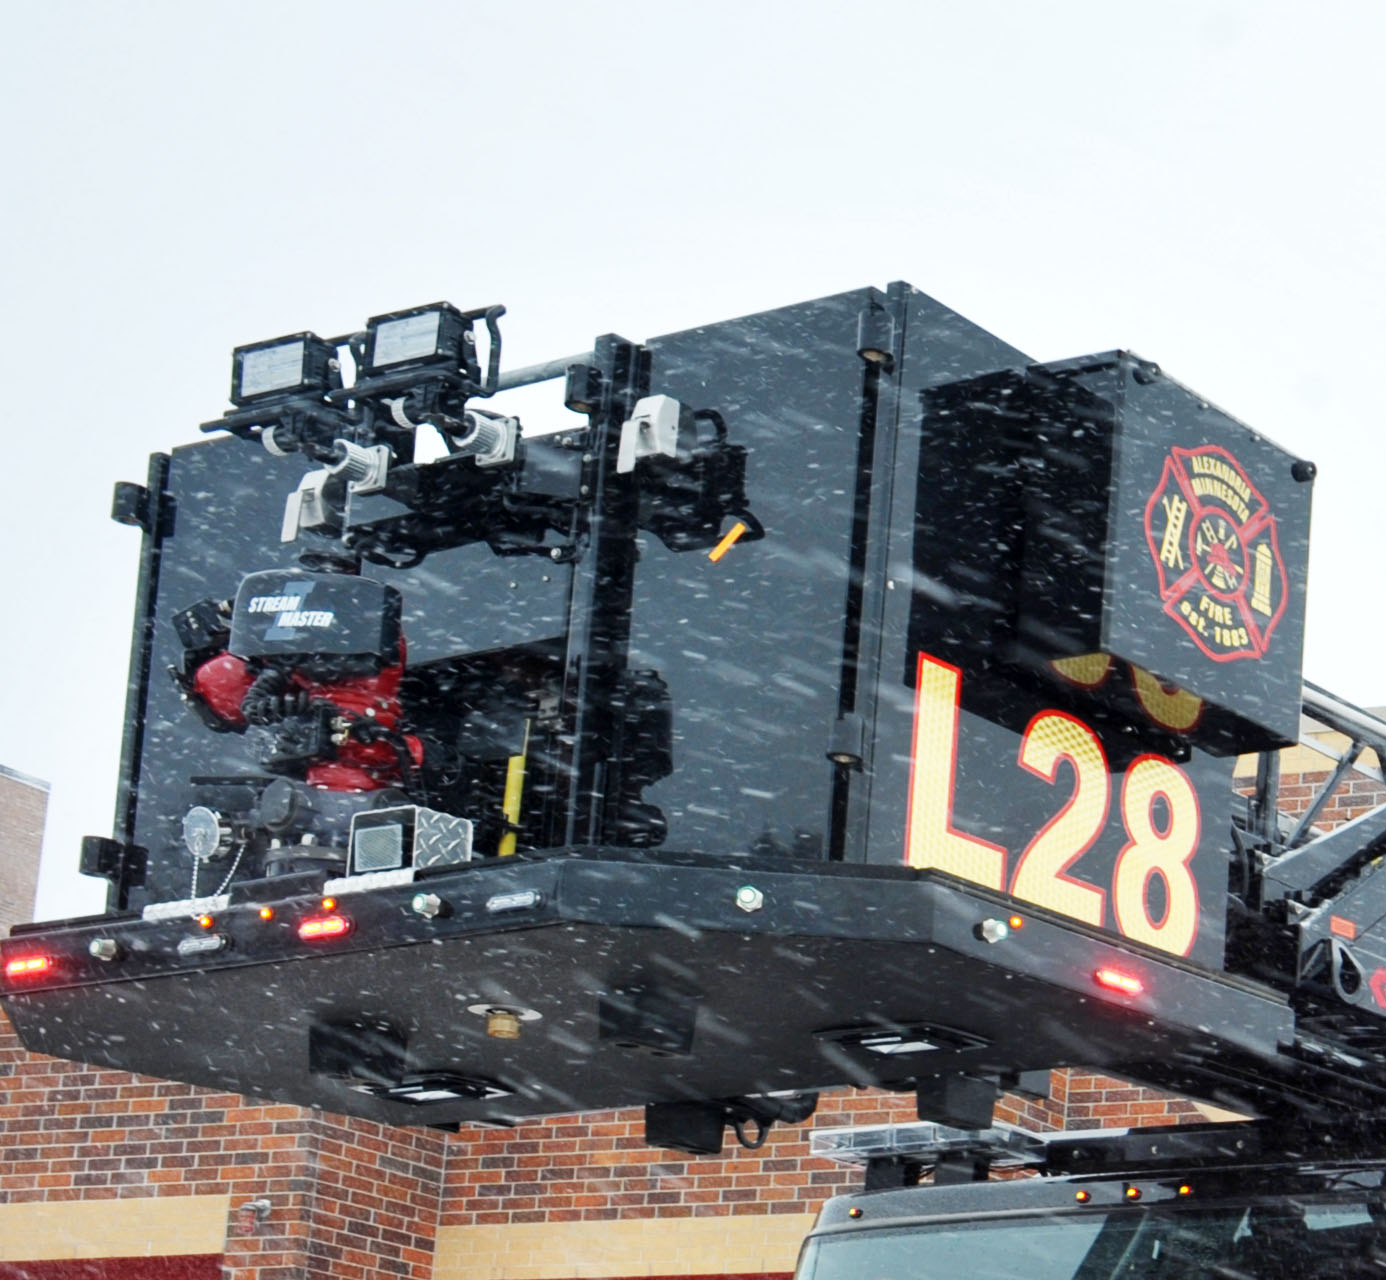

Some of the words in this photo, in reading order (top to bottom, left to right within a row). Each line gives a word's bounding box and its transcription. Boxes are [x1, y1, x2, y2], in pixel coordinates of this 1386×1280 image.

[1192, 477, 1249, 523] MINNESOTA
[248, 596, 301, 613] STREAM
[277, 611, 334, 627] MASTER
[1199, 595, 1233, 625] FIRE
[904, 652, 1201, 957] L28
